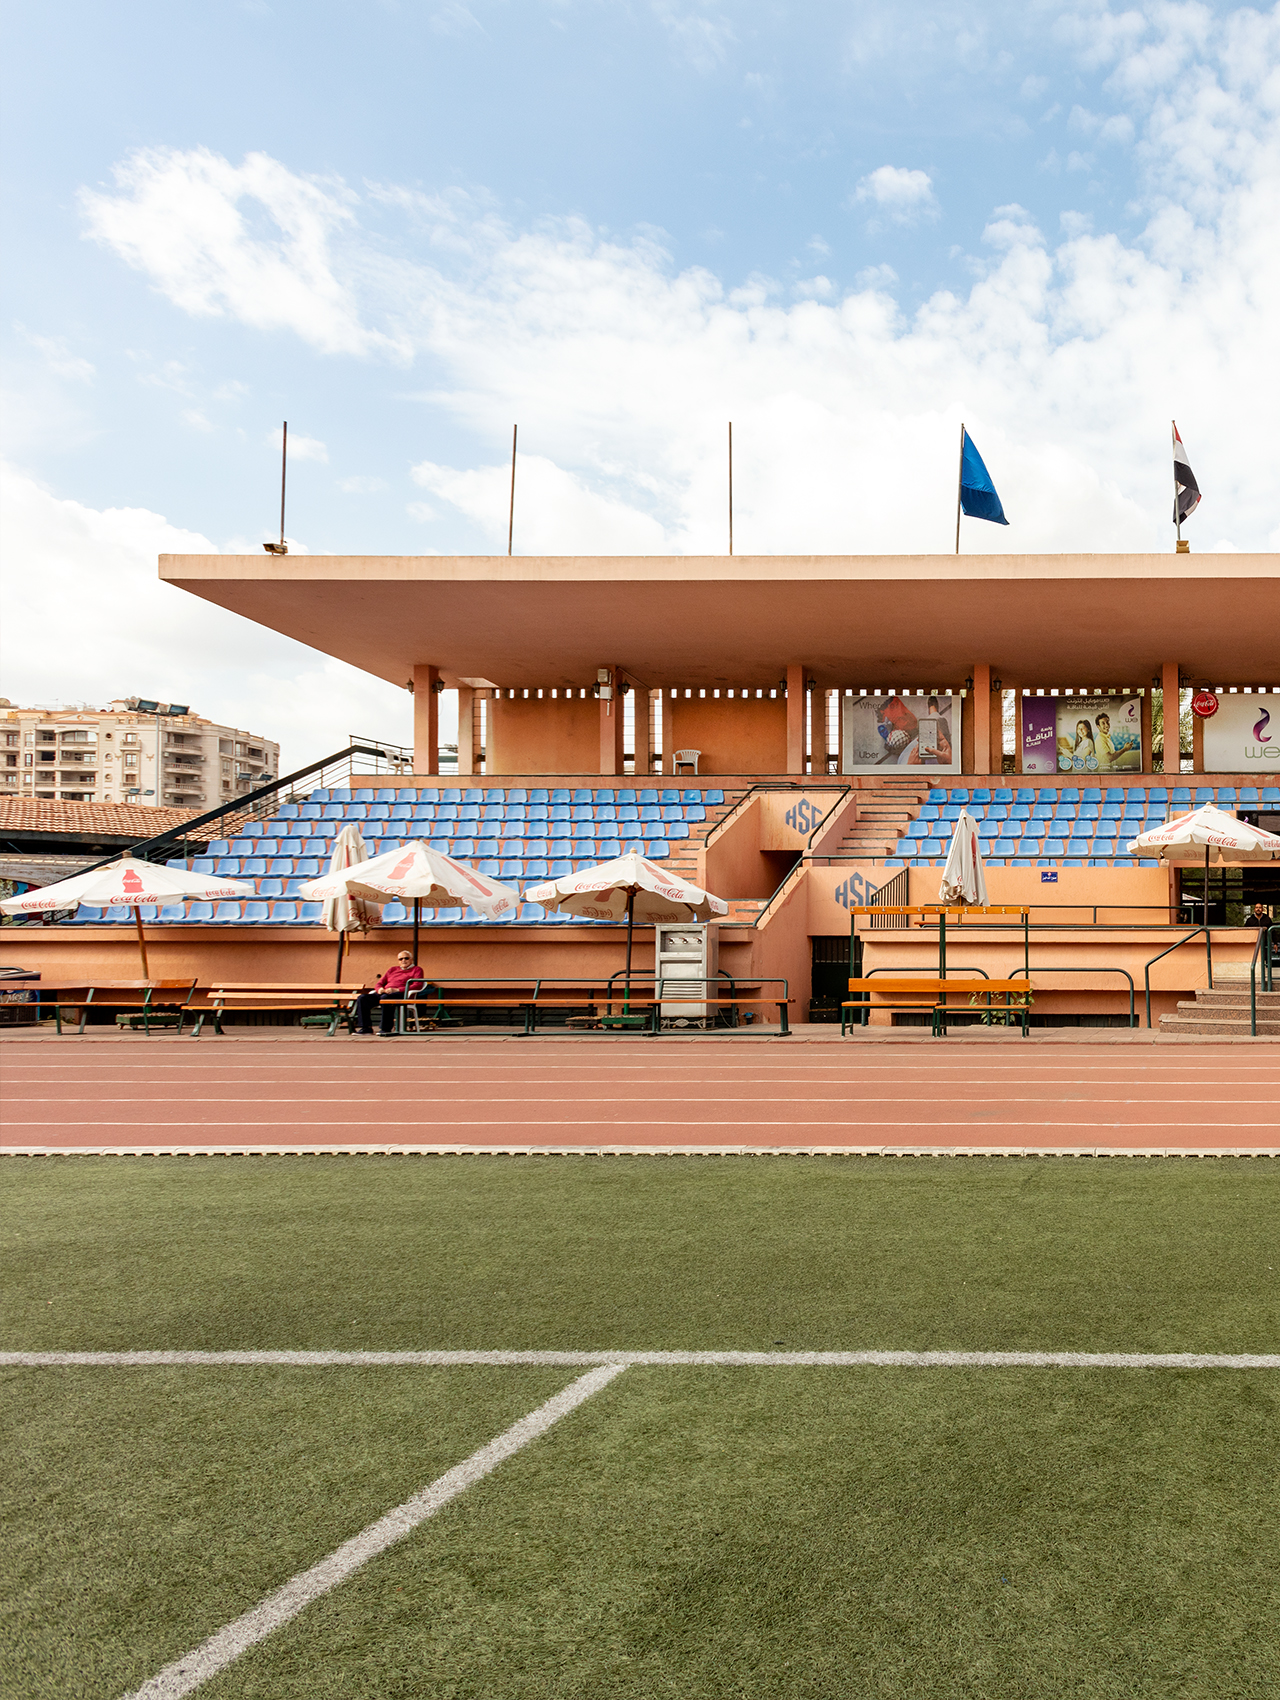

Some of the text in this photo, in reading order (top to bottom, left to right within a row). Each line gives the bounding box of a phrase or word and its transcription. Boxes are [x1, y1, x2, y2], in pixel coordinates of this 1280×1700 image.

[859, 751, 879, 759] Uber
[1244, 746, 1280, 758] we
[785, 798, 823, 835] HSC
[835, 872, 878, 910] HSC
